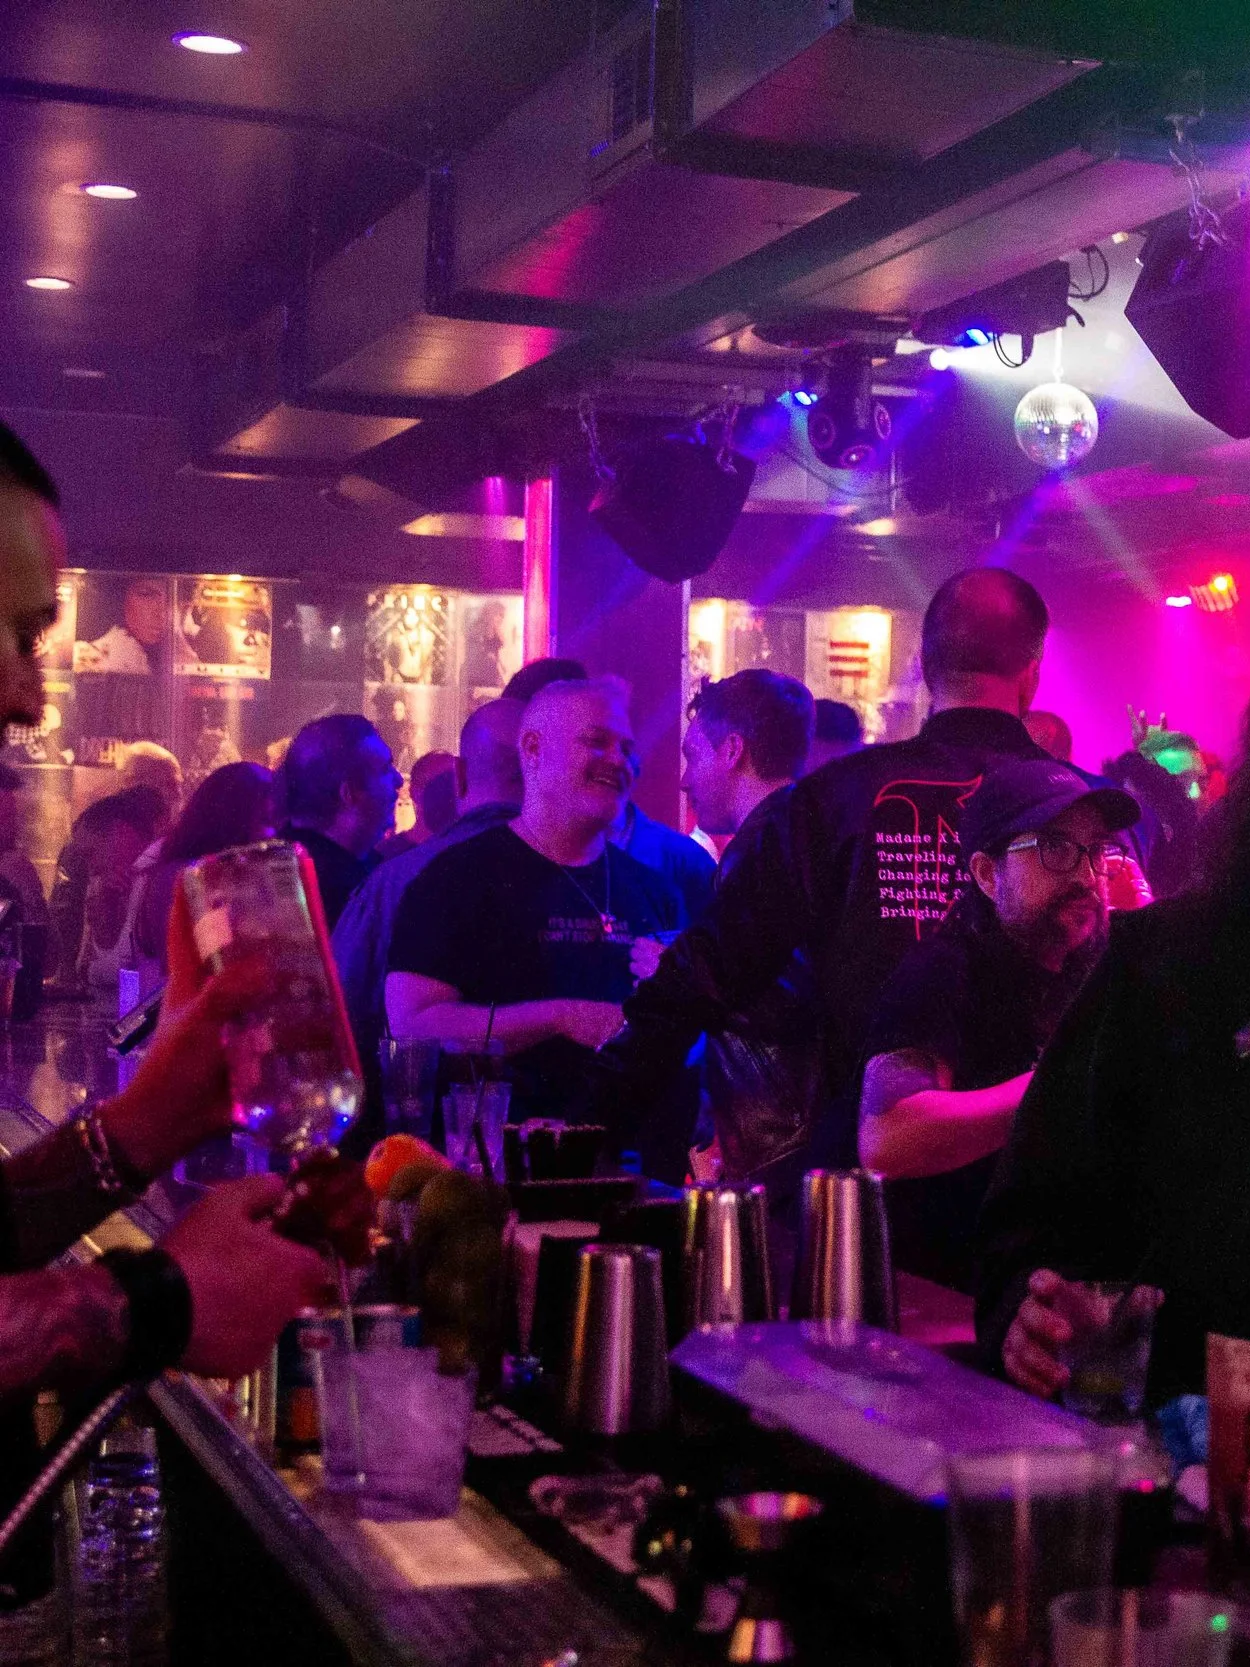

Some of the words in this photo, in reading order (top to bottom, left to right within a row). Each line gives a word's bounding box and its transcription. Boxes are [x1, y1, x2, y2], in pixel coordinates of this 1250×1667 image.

[875, 832, 932, 844] Madame
[938, 832, 948, 844] X
[877, 850, 957, 866] Traveling
[878, 869, 950, 885] Changing
[879, 886, 947, 903] Fighting
[880, 904, 947, 922] Bringing
